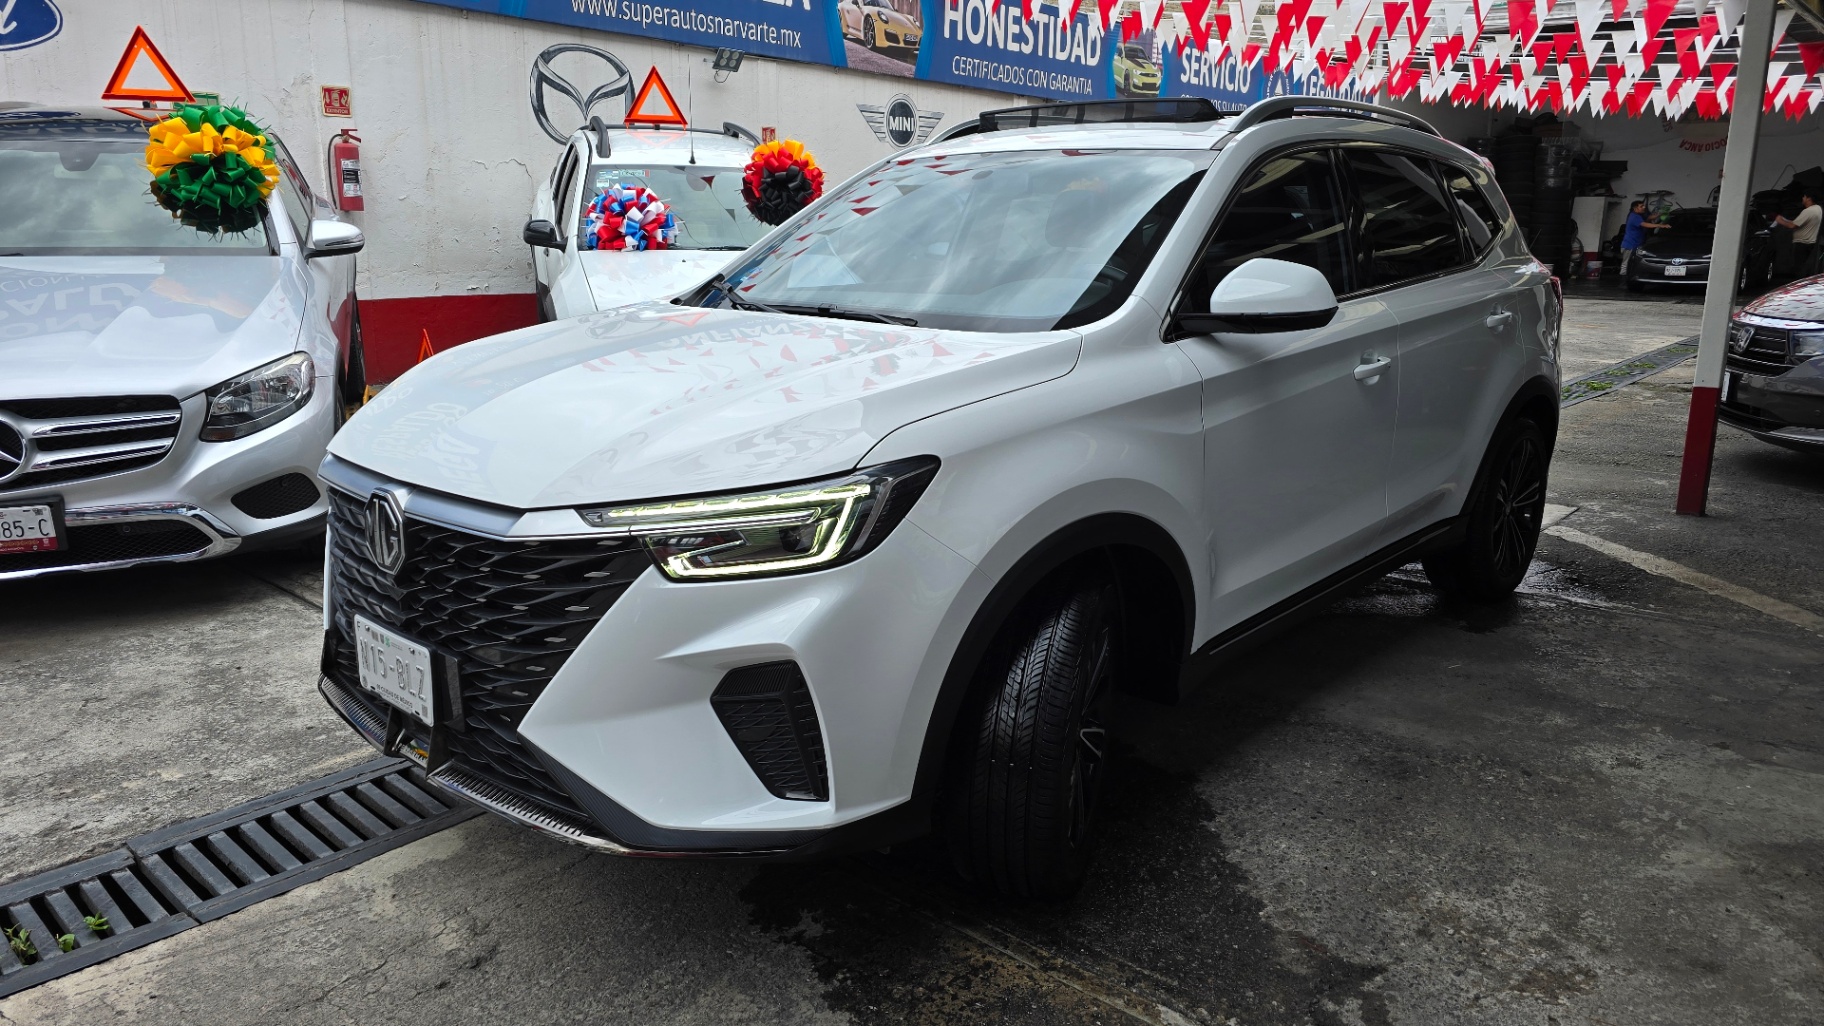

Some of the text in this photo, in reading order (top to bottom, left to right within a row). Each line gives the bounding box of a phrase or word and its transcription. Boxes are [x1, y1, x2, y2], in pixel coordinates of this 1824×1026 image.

[571, 0, 801, 48] www.superautosnarvarte.mx
[944, 0, 1101, 66] HONESTIDAD
[952, 55, 1093, 95] CERTIFICADOS CON GARANTIA
[1180, 46, 1251, 93] SERVICIO
[889, 115, 915, 132] MINI
